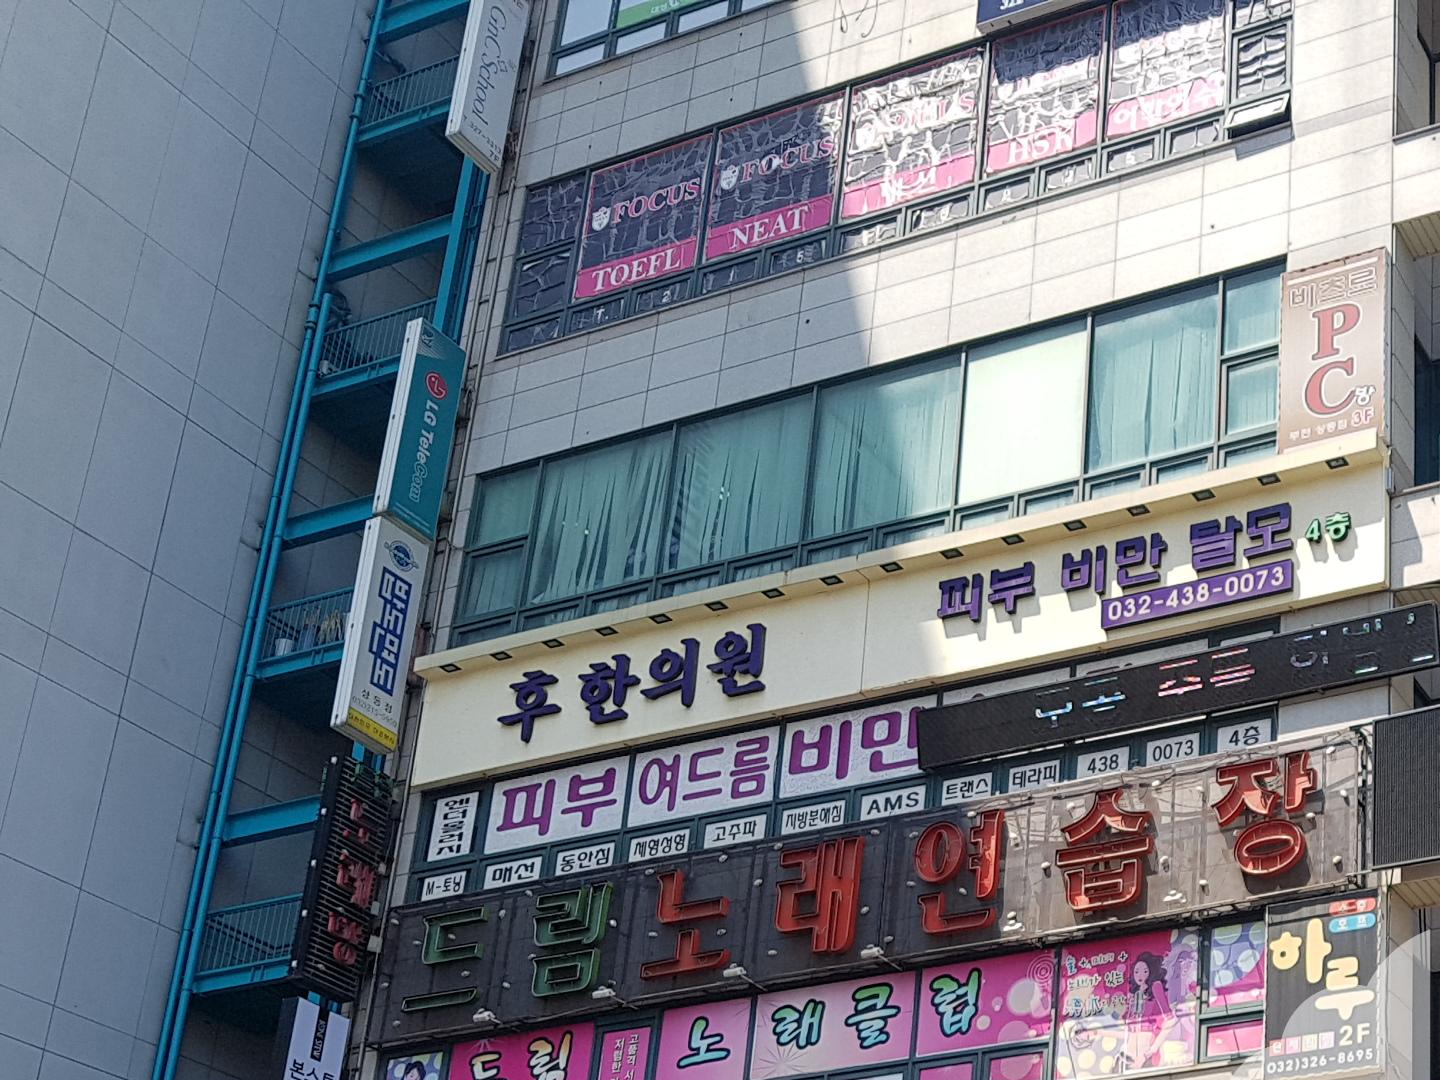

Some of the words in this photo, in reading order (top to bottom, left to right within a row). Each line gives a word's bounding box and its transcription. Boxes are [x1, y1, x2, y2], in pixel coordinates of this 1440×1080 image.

[471, 53, 498, 125] School
[740, 136, 834, 184] FOCUS
[612, 178, 701, 224] FOCUS
[729, 205, 809, 251] NEAT
[592, 247, 683, 293] TOEFL
[423, 399, 439, 428] LG
[1351, 407, 1376, 428] 3F
[937, 560, 1036, 622] 피부
[1061, 532, 1168, 596] 비만
[1190, 502, 1294, 574] 탈모
[1306, 510, 1352, 544] 4층
[1107, 566, 1286, 622] 032-438-0073
[497, 622, 768, 743] 후한의원
[497, 767, 618, 837] 피부
[638, 735, 771, 812] 여드름
[788, 707, 922, 781] 비만
[491, 861, 536, 884] 매선
[560, 847, 612, 873] 동안침
[711, 819, 757, 843] 고주파
[867, 791, 921, 816] AMS
[945, 777, 992, 803] 트랜스
[1011, 764, 1059, 790] 테라피
[1087, 754, 1120, 775] 438
[1152, 739, 1195, 763] 0073
[1229, 726, 1262, 748] 4층
[401, 881, 615, 1012] 드림
[640, 752, 1319, 981] 노래연습장
[1270, 918, 1376, 1020] 하루
[1267, 1048, 1373, 1074] 032)326-8695
[1339, 1023, 1371, 1047] 2F
